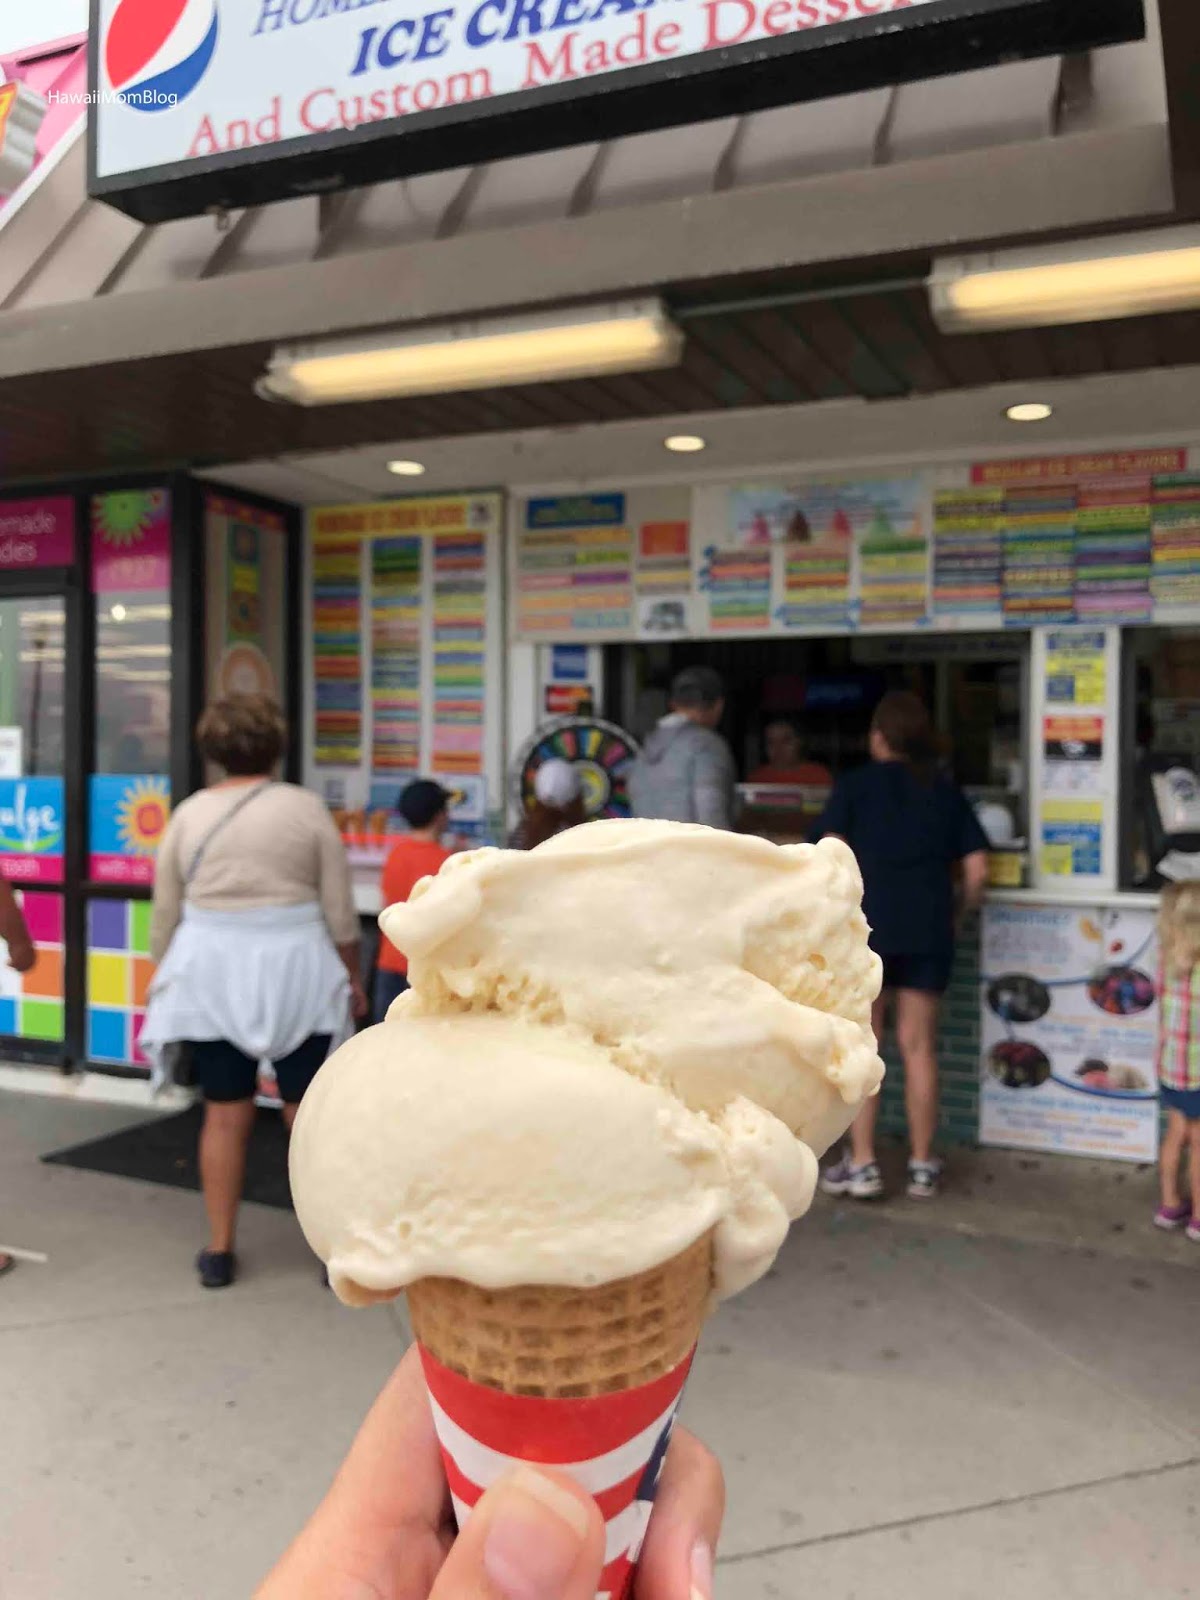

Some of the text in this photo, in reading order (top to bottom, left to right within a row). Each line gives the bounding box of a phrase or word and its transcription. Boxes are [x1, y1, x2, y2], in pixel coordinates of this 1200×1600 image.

[185, 95, 284, 156] And
[300, 66, 493, 134] Custom
[521, 12, 682, 89] Made
[349, 0, 662, 77] ICE CRE
